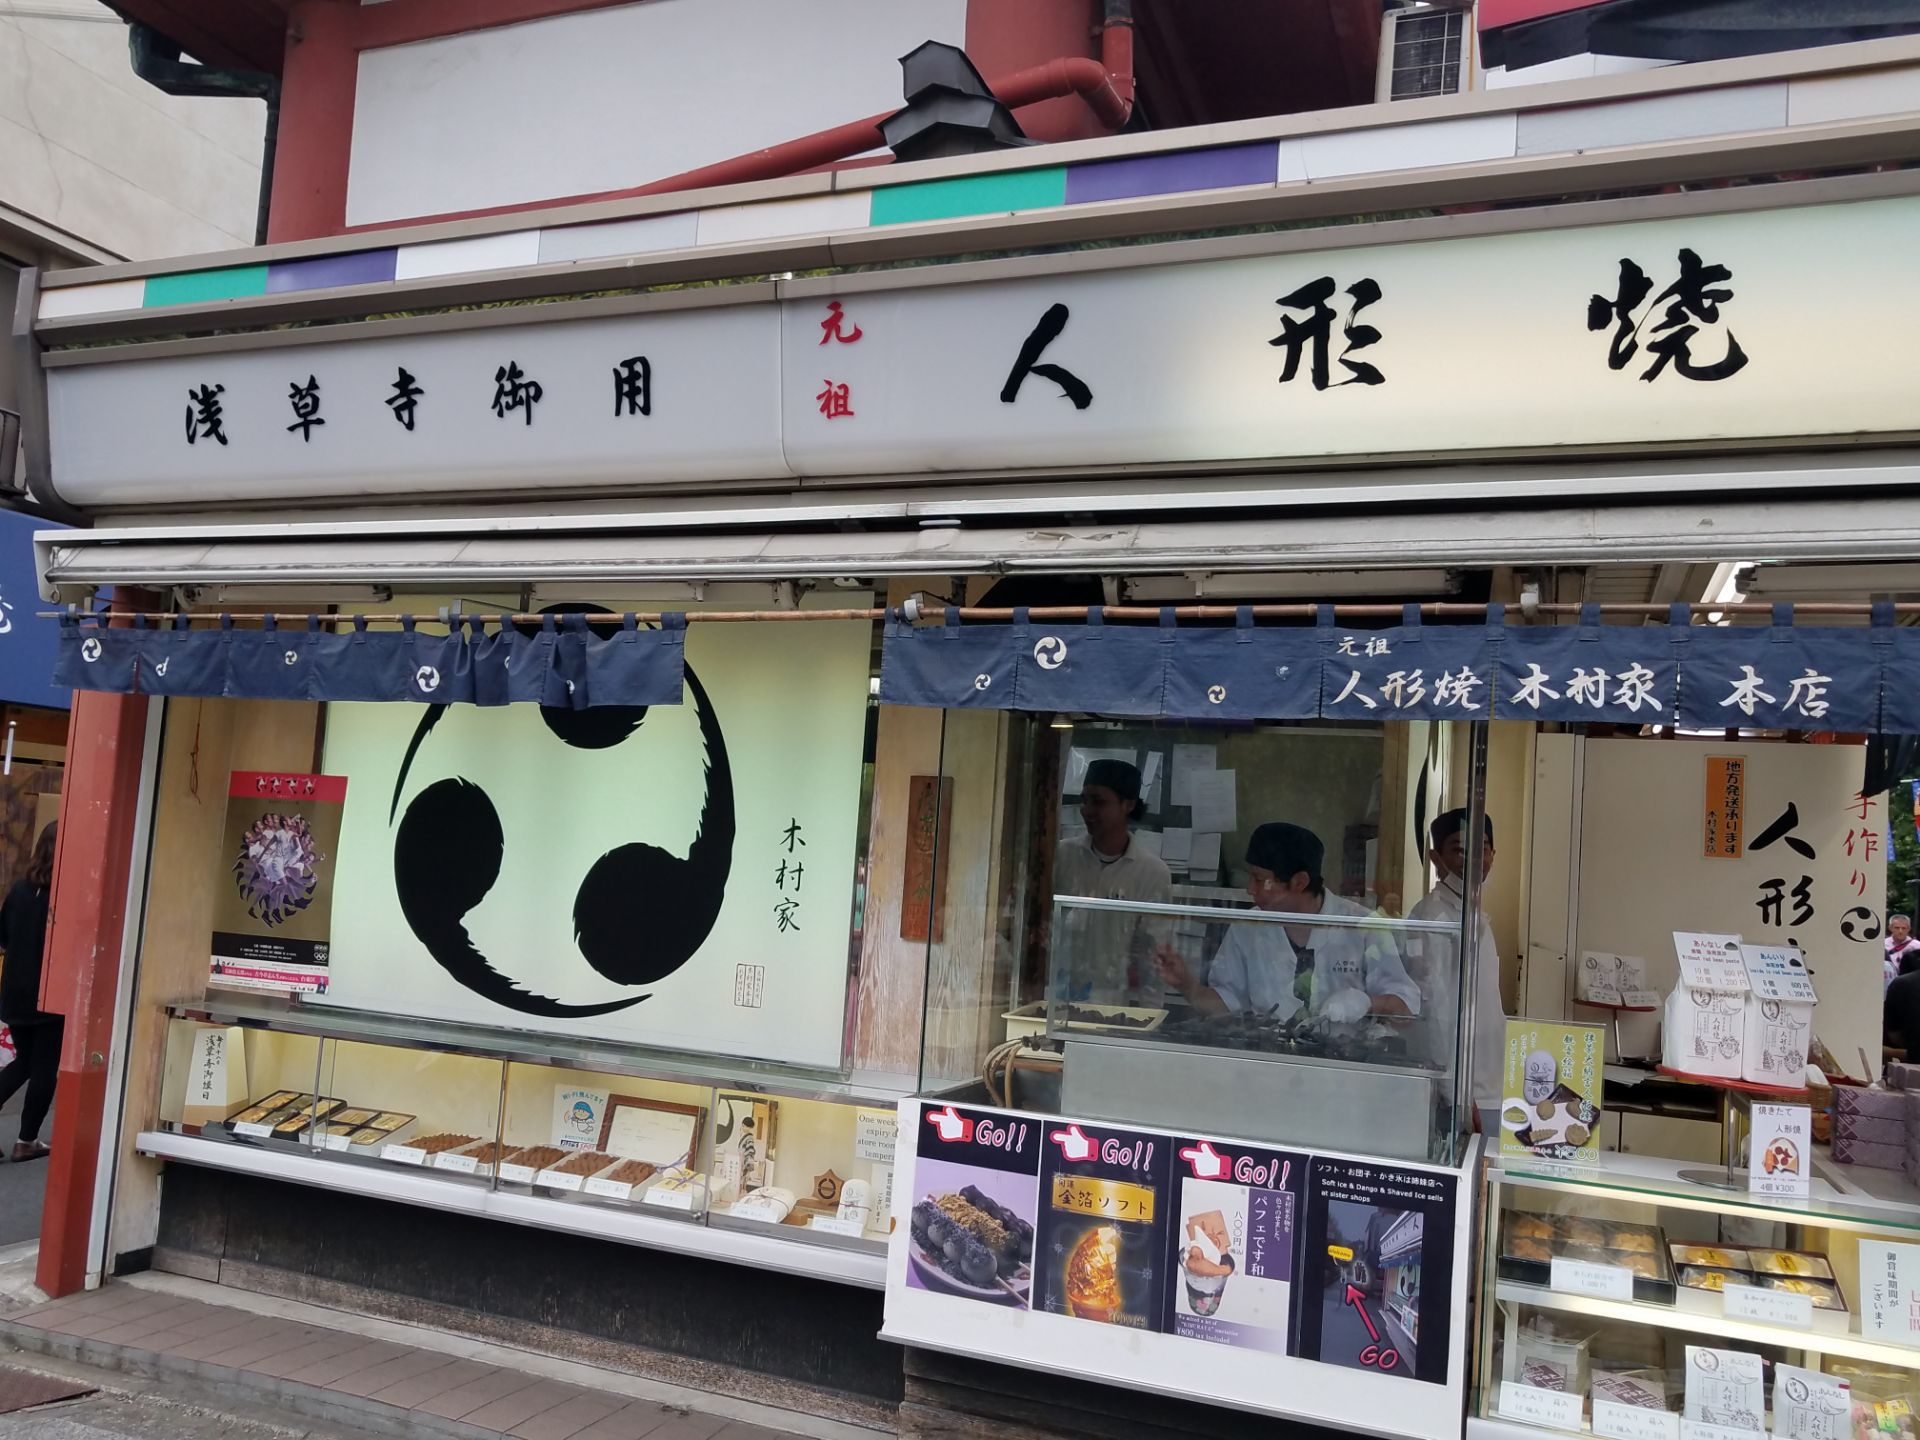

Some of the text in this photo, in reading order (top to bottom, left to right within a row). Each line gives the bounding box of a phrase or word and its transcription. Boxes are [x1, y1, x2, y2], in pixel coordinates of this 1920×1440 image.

[1000, 247, 1748, 411] 人形焼
[817, 301, 862, 420] 元祖
[184, 355, 653, 447] 浅草寺御用
[1335, 634, 1392, 659] 元祖
[1332, 662, 1833, 719] 人形焼 木村家 本店
[1725, 761, 1741, 854] 地方発送承ります
[1842, 792, 1879, 897] 手作り
[774, 817, 806, 933] 木村家
[859, 1114, 875, 1124] One
[866, 1128, 890, 1138] expiry
[976, 1120, 1027, 1153] Go!!
[1101, 1138, 1154, 1171] Go!!
[1234, 1155, 1291, 1191] Go!!
[1058, 1189, 1147, 1215] 金箔ソフト
[1356, 1184, 1378, 1194] Dango
[1387, 1188, 1413, 1199] Shaved
[1360, 1345, 1399, 1370] GO
